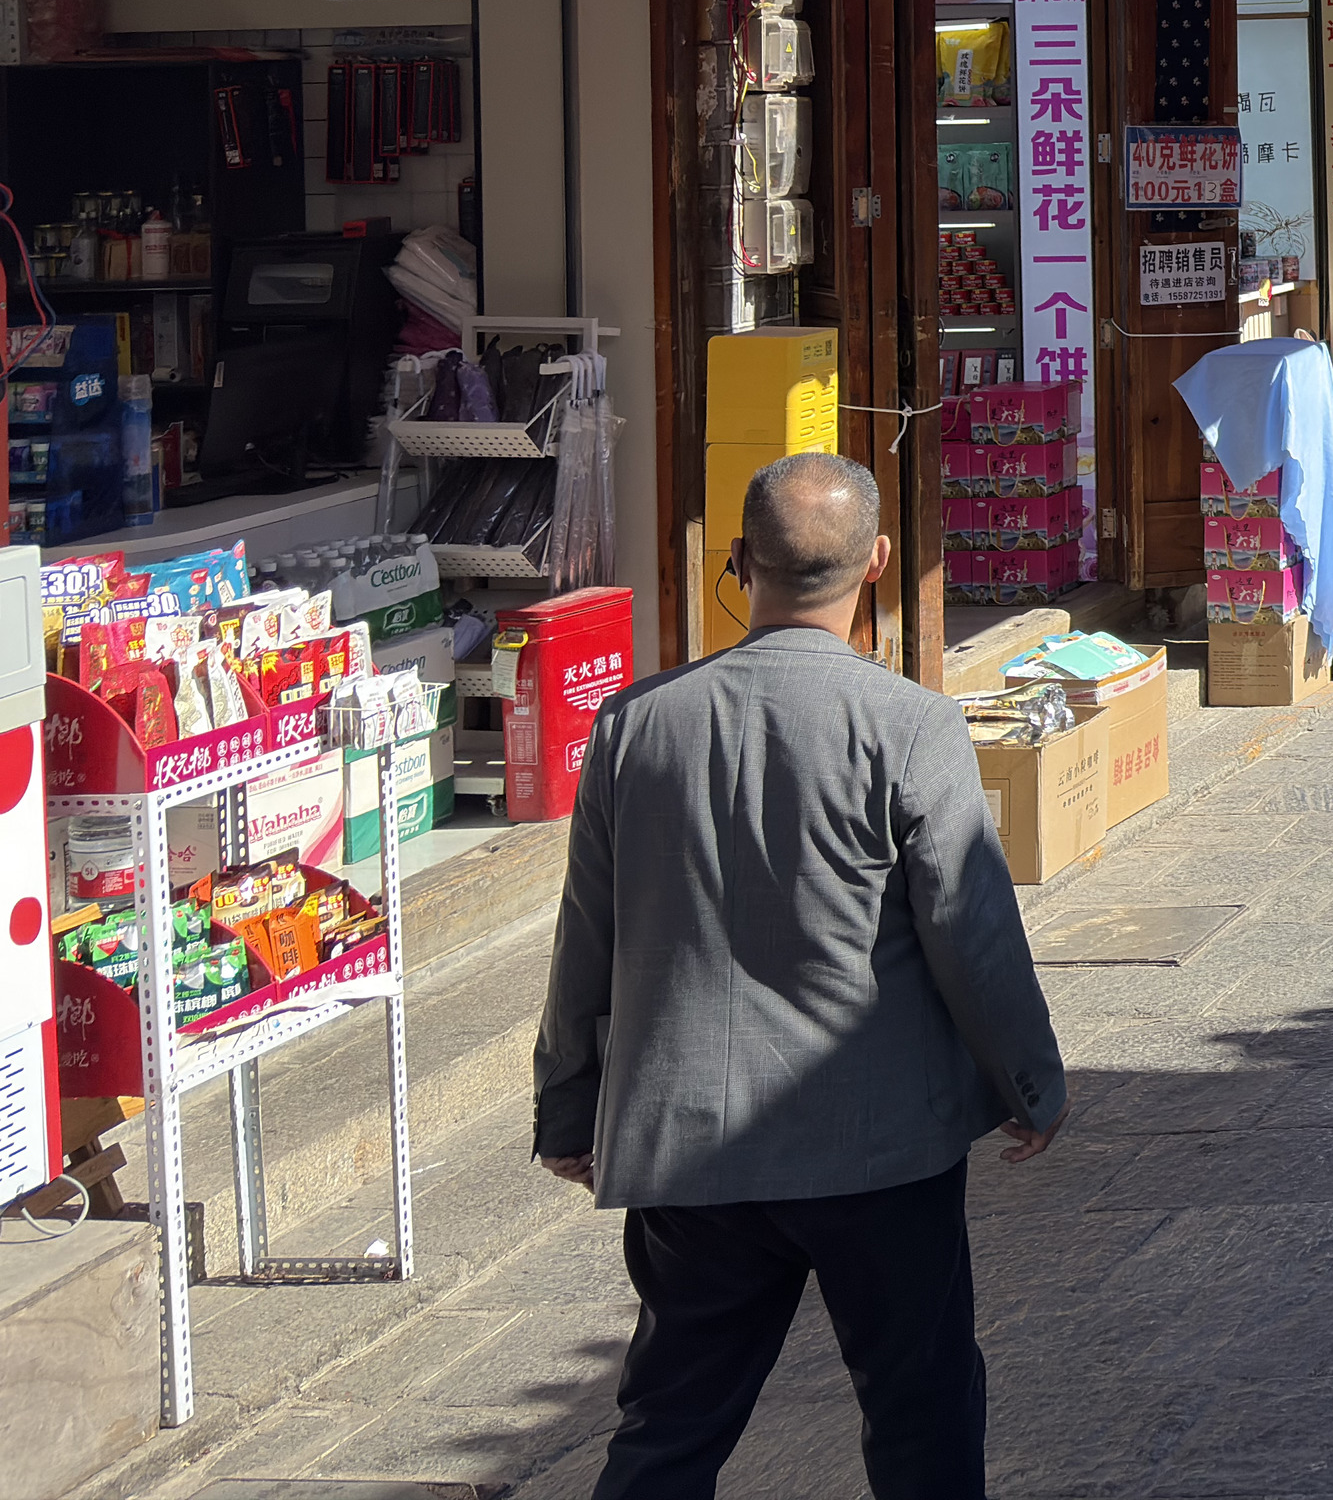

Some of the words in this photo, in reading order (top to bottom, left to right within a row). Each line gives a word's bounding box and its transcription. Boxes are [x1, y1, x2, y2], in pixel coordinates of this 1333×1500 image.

[958, 52, 969, 93] 玫瑰鲜花饼
[1132, 134, 1238, 172] 40克鲜花饼
[1029, 24, 1088, 393] 三朵鲜花一个饼
[1142, 248, 1224, 274] 招聘销售员
[1150, 276, 1216, 289] 待遇进店咨询
[1168, 290, 1223, 301] 15587251391
[75, 381, 103, 400] 益达
[370, 560, 422, 587] C'estbon
[564, 653, 623, 685] 灭火器箱
[563, 687, 576, 696] FIRE
